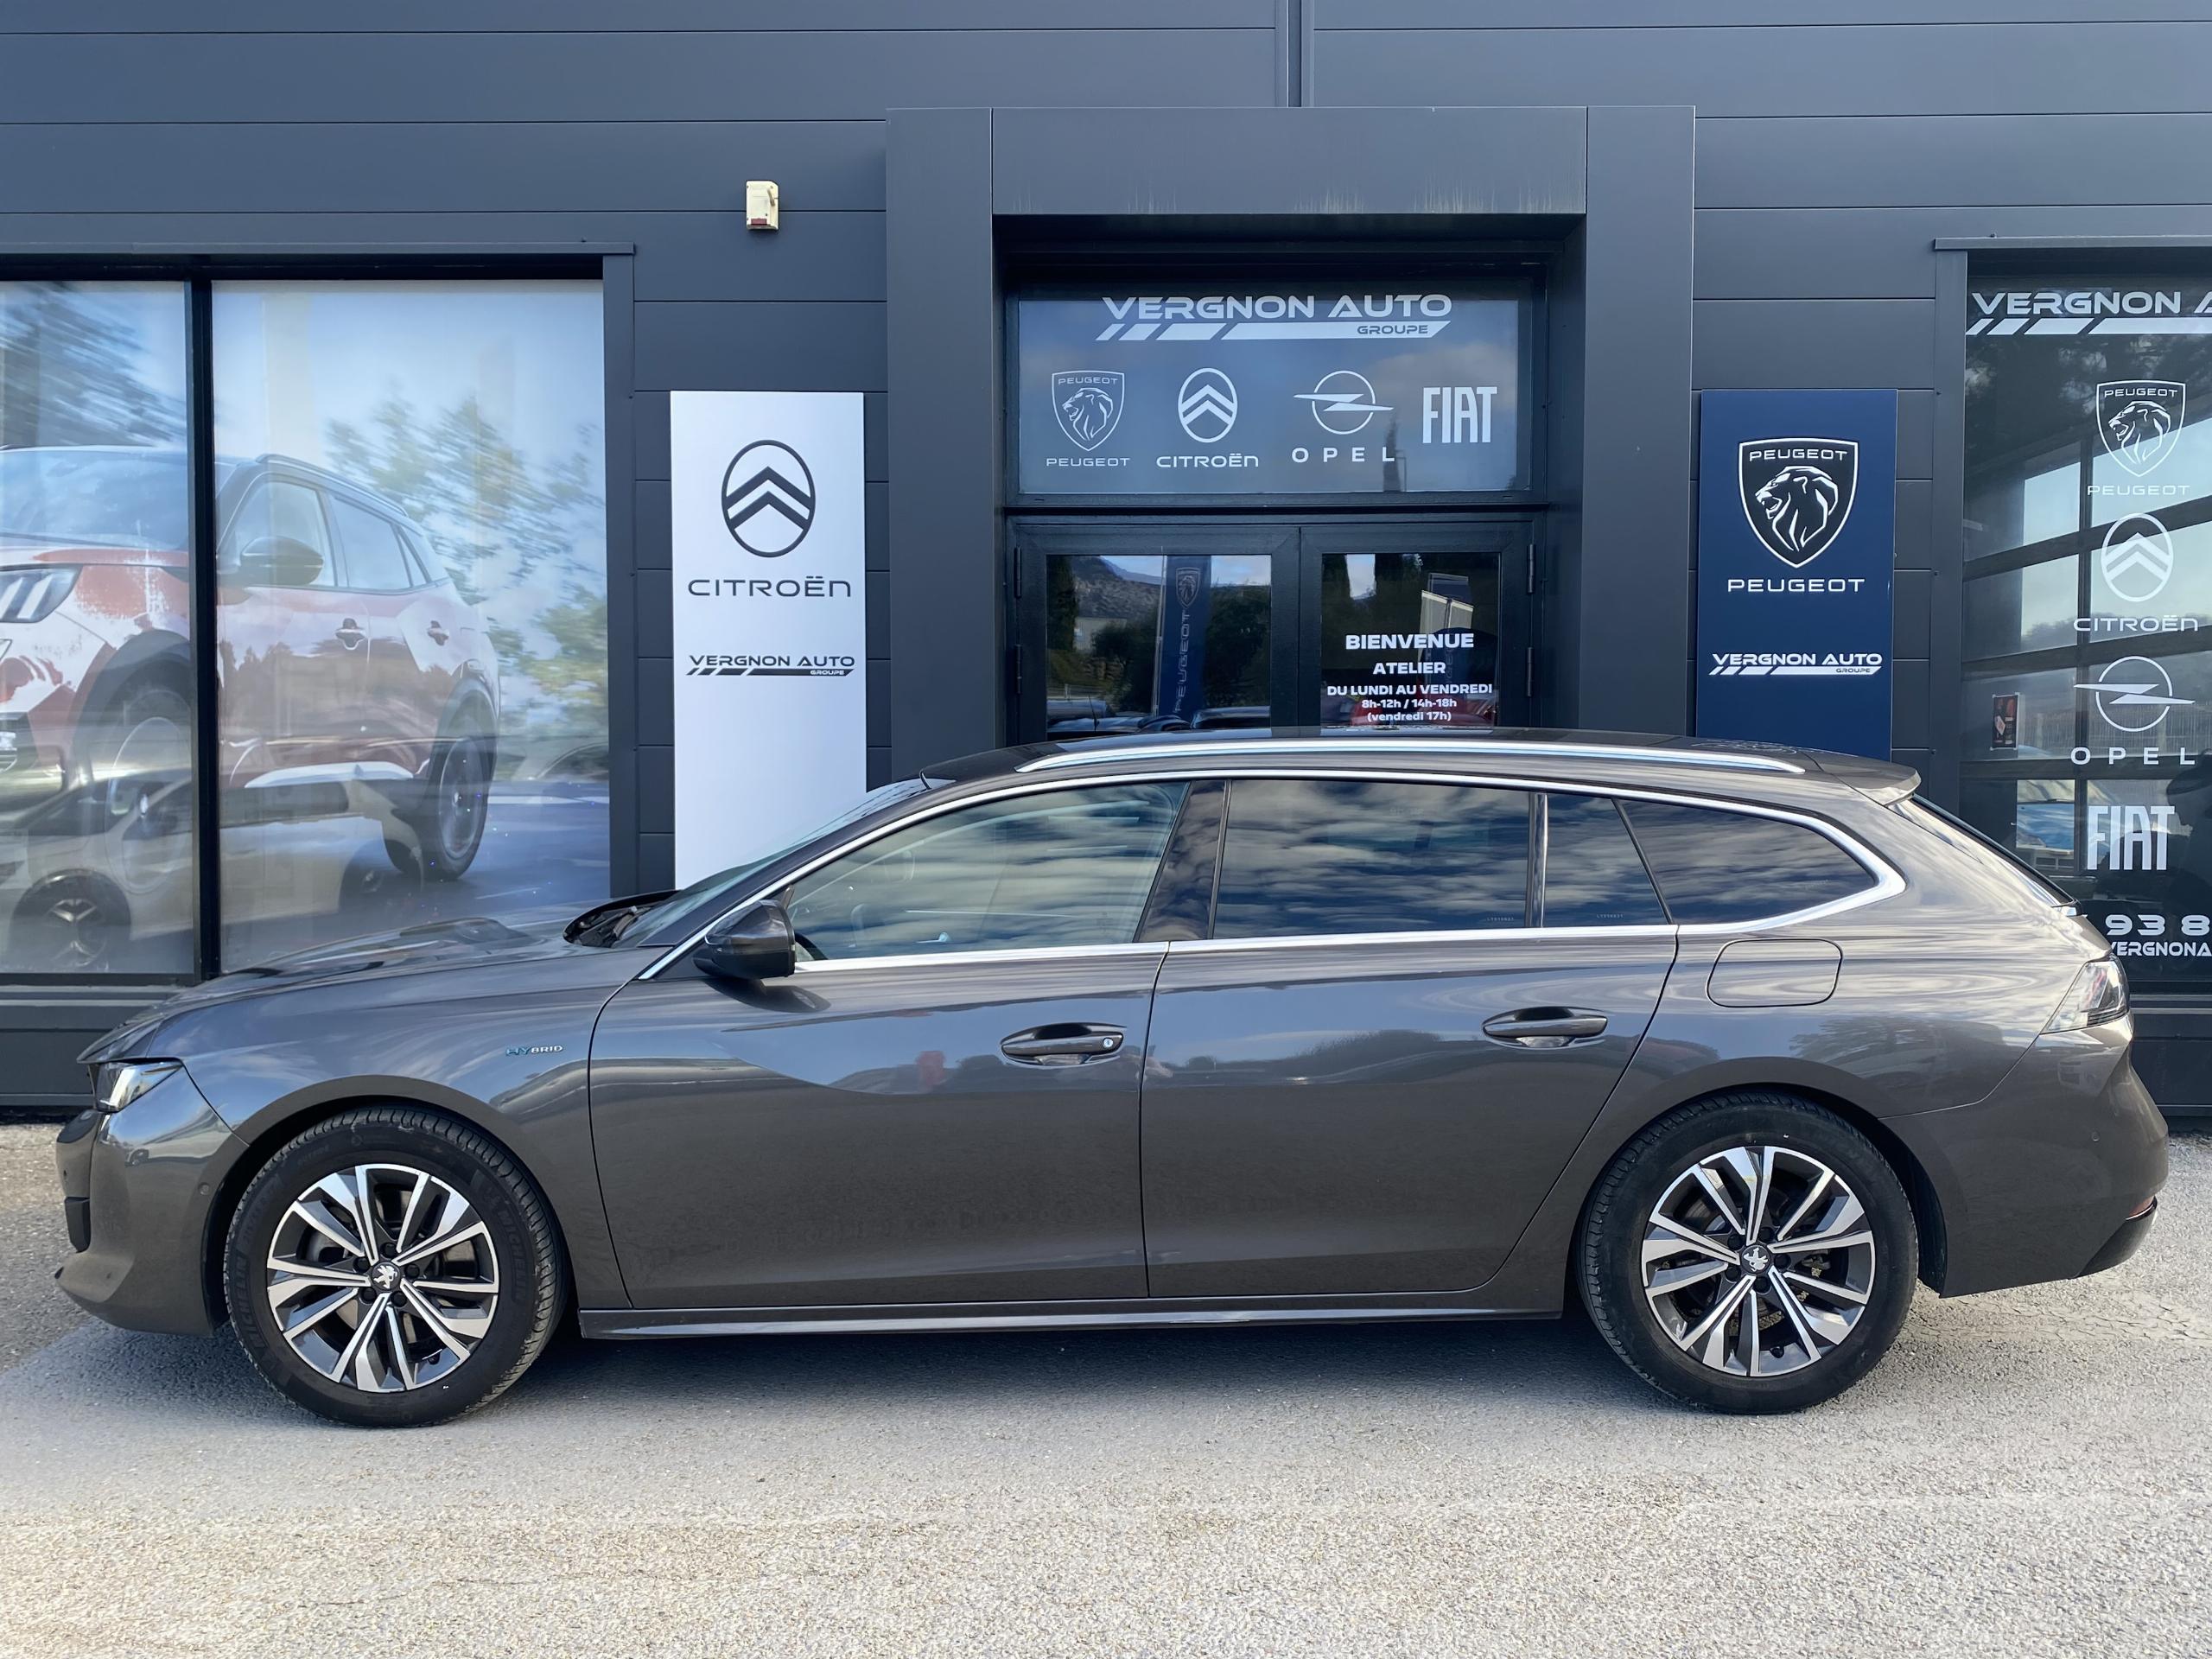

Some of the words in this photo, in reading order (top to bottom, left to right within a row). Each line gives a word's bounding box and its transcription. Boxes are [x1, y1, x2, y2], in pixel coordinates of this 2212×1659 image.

[1102, 296, 1315, 320] VERGNON
[1327, 294, 1452, 318] AUTO
[1972, 291, 2181, 315] VERGNON
[1357, 325, 1429, 335] GROUPE
[1058, 377, 1118, 385] PEUGEOT
[2104, 388, 2178, 397] PEUGEOT
[1422, 386, 1497, 444] FIAT
[1292, 448, 1395, 463] OPEL
[1749, 448, 1848, 462] PEUGEOT
[1046, 457, 1130, 467] PEUGEOT
[2087, 485, 2190, 496] PEUGEOT
[1727, 578, 1866, 593] PEUGEOT
[1345, 632, 1474, 649] BIENVENUE
[690, 655, 790, 666] VERGNON
[797, 656, 855, 667] AUTO
[1712, 653, 1816, 665] VERGNON
[1821, 653, 1883, 665] AUTO
[1373, 662, 1446, 675] ATELIER
[1327, 685, 1347, 696] DU
[1351, 685, 1393, 696] LUNDI
[1395, 684, 1416, 695] AU
[1420, 683, 1492, 695] VENDREDI
[1361, 698, 1402, 709] 8h-12h
[1411, 698, 1457, 708] 14h-18h
[1367, 711, 1424, 721] (vendredi
[1426, 711, 1452, 721] 17h)
[2070, 747, 2196, 766] OPEL
[2087, 805, 2175, 870] FIAT
[2105, 914, 2165, 936] 93
[505, 1045, 563, 1056] HYBRID
